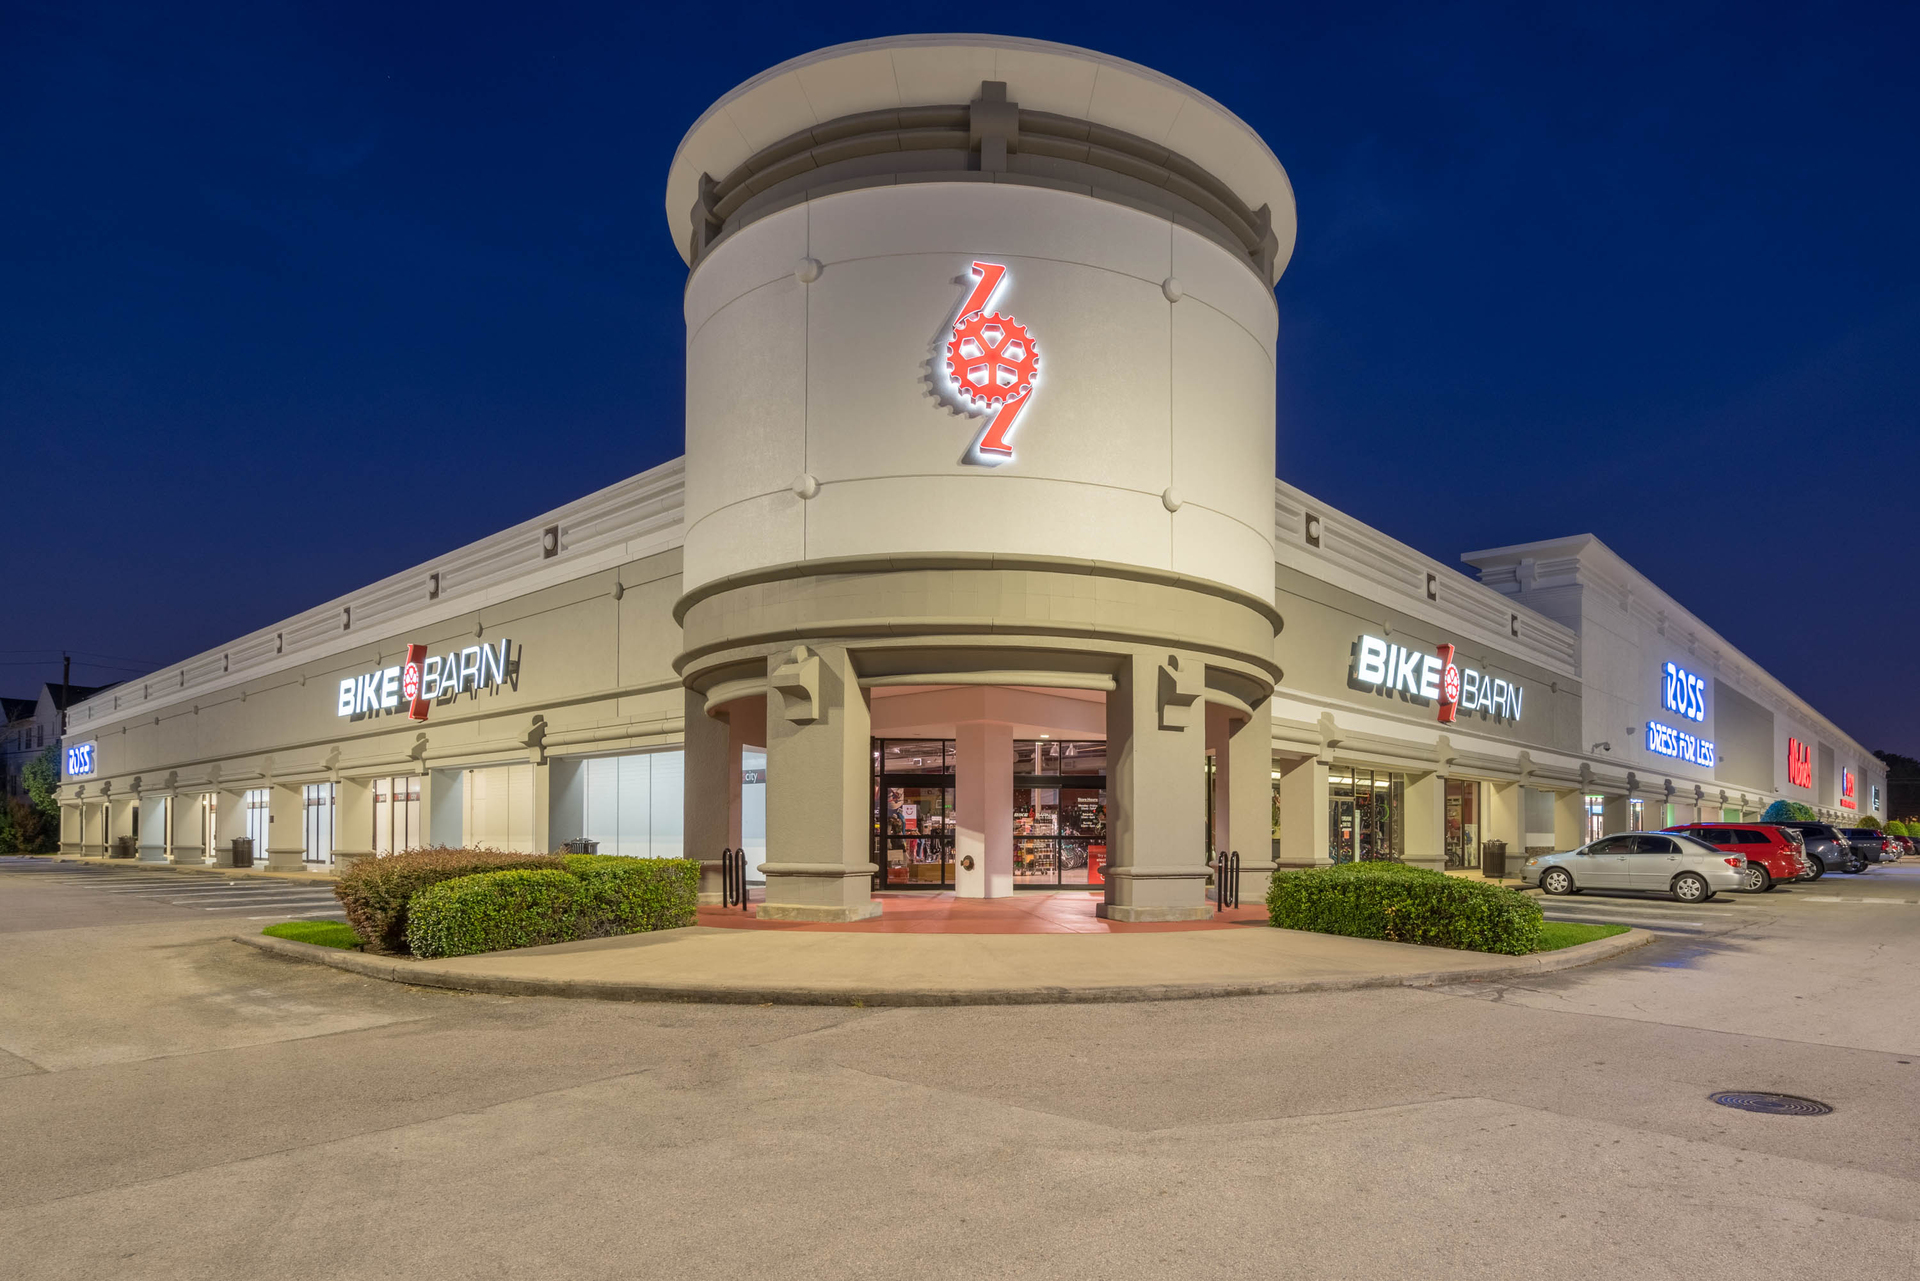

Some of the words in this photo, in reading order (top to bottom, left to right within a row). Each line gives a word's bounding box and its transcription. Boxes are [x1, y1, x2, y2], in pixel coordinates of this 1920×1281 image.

[338, 666, 401, 717] BIKE
[421, 638, 509, 701] BARN
[1358, 634, 1442, 700] BIKE
[1461, 669, 1523, 721] BARN
[1667, 662, 1705, 722] ROSS
[68, 744, 91, 775] ROSS
[1649, 721, 1678, 757] DRESS
[1679, 732, 1696, 762] FOR
[1696, 739, 1714, 767] LESS
[745, 770, 758, 784] city
